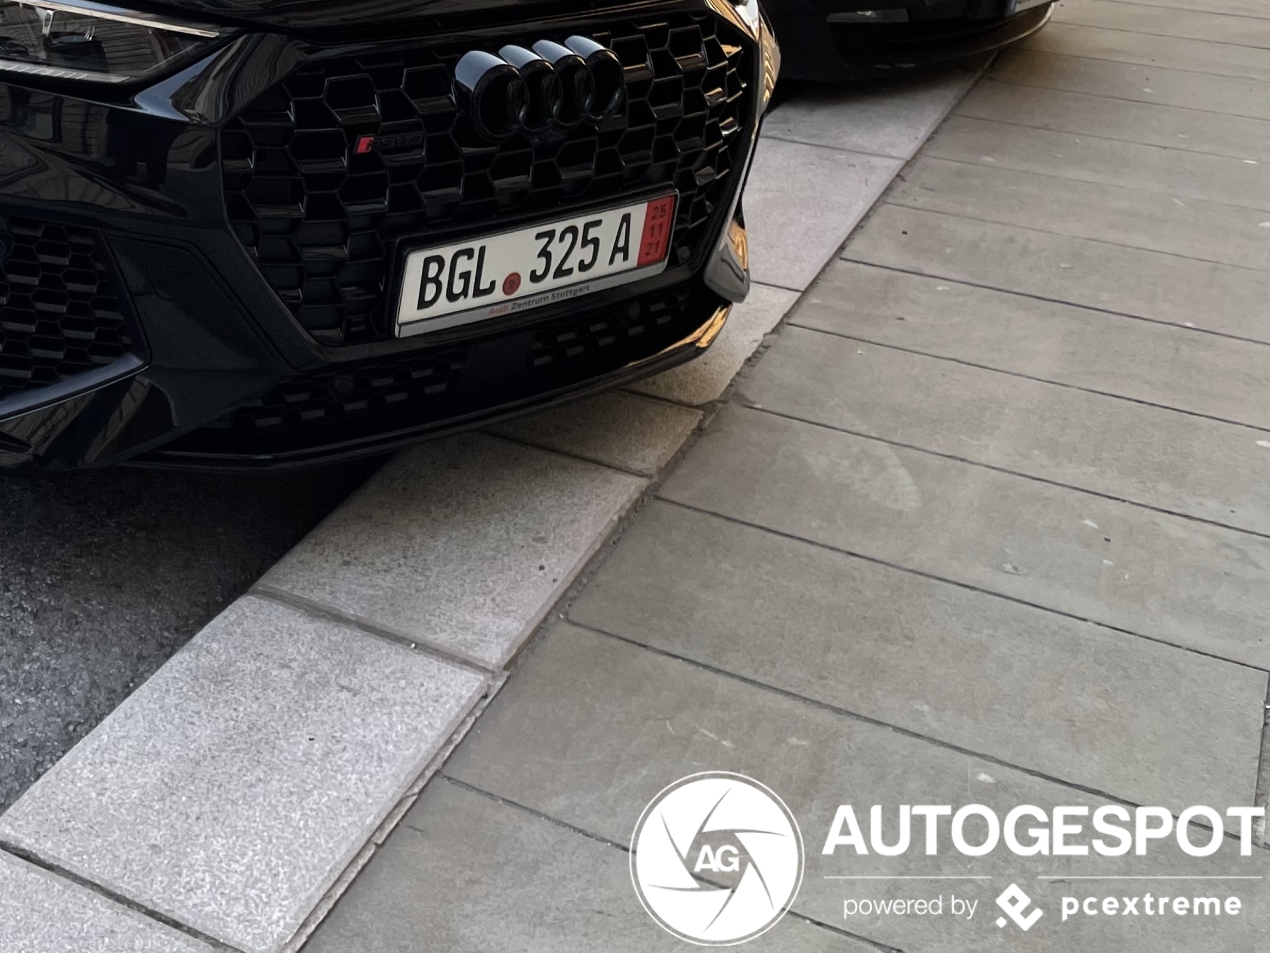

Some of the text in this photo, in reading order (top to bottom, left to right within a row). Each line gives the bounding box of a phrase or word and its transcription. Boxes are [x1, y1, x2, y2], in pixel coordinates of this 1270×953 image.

[651, 204, 667, 221] 25
[650, 222, 663, 238] 11
[645, 240, 659, 256] 21
[416, 213, 632, 311] BGL 325 A
[488, 284, 591, 316] Audi Zentrum Stuttgart
